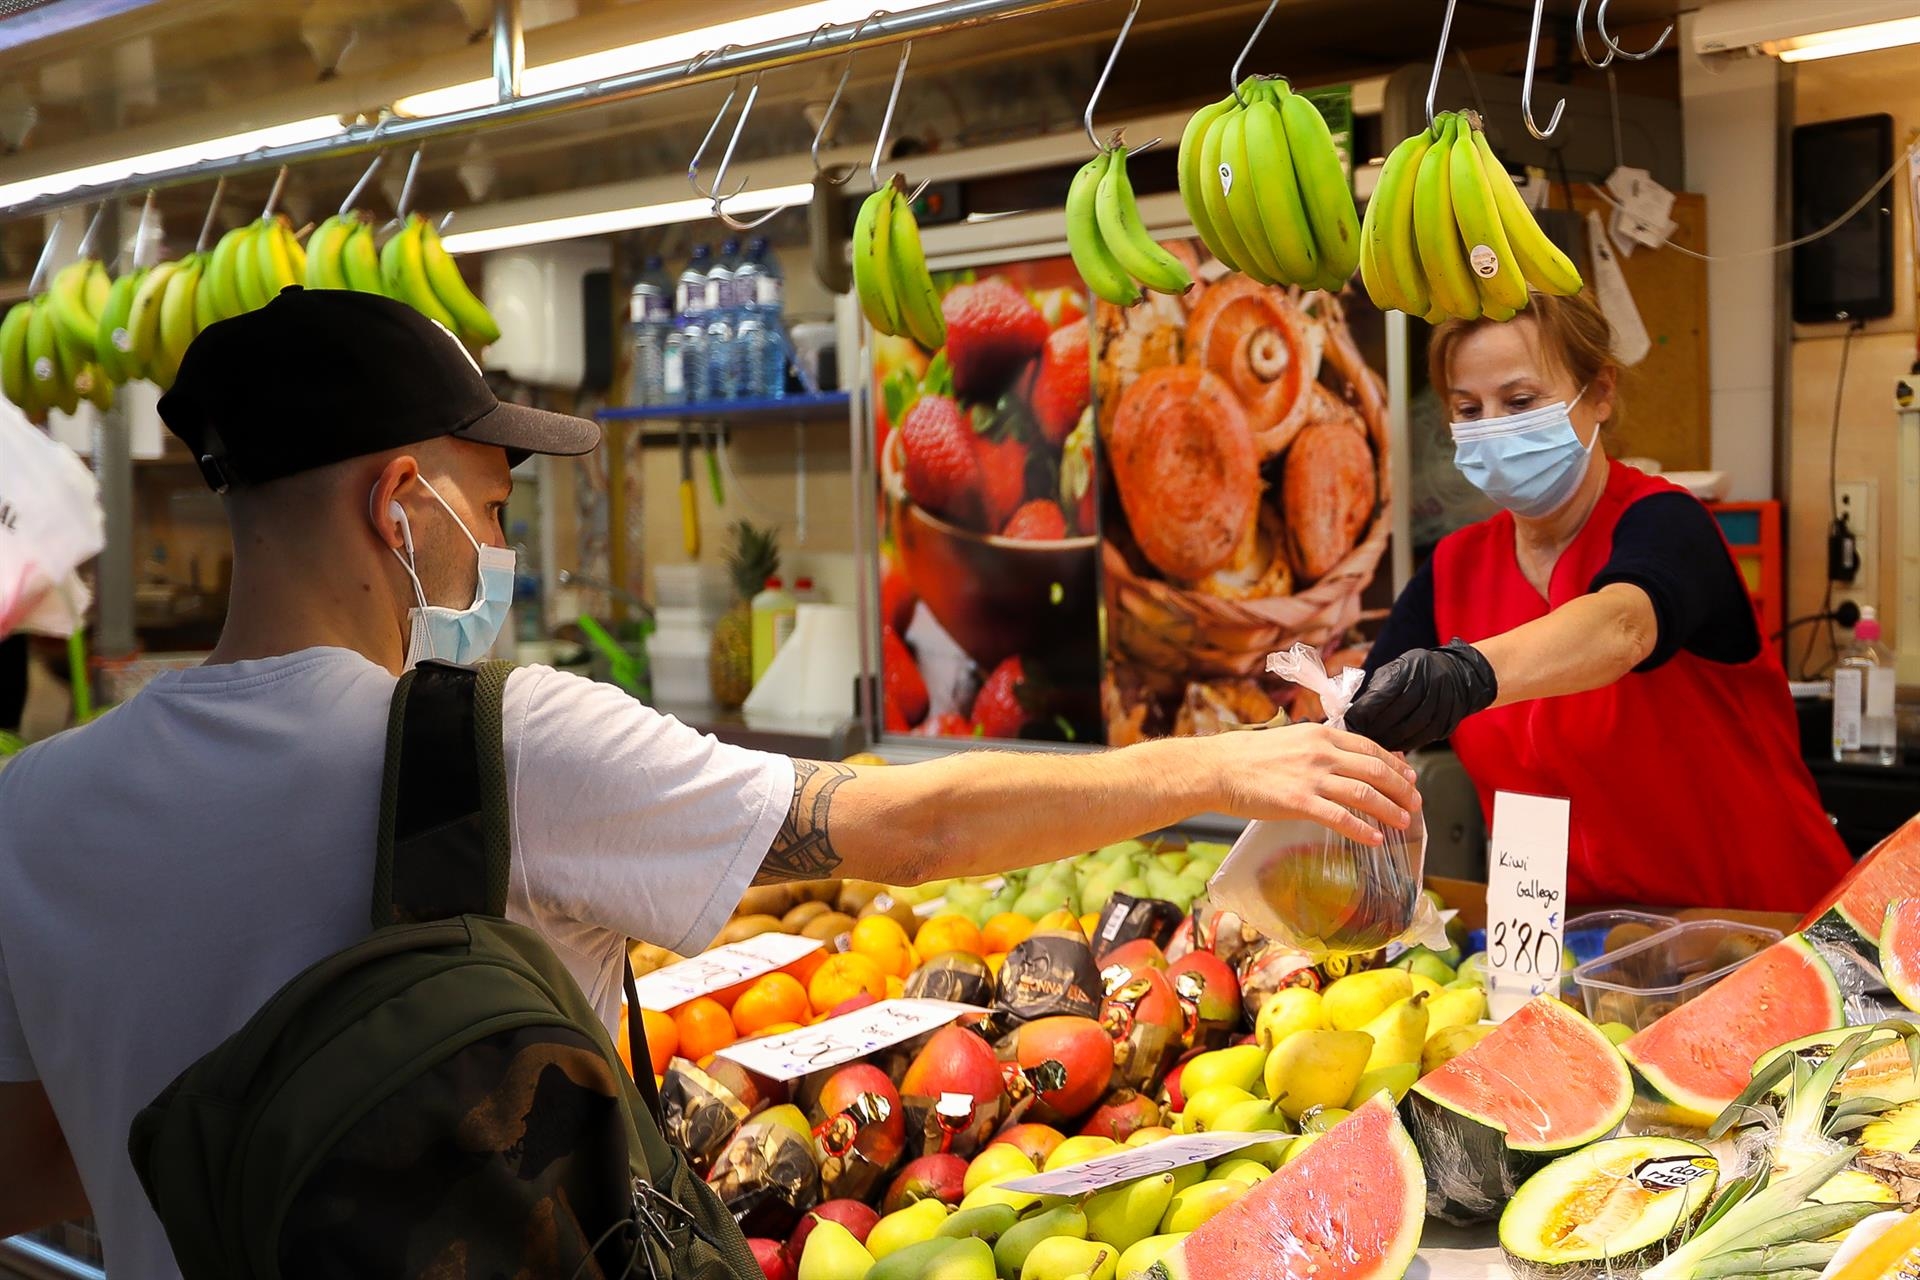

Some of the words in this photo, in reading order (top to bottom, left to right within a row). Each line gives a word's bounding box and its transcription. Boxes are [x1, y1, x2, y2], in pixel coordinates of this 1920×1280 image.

[1499, 851, 1528, 871] Kiwi
[1516, 880, 1559, 909] Gallego
[1491, 918, 1559, 981] 3'80
